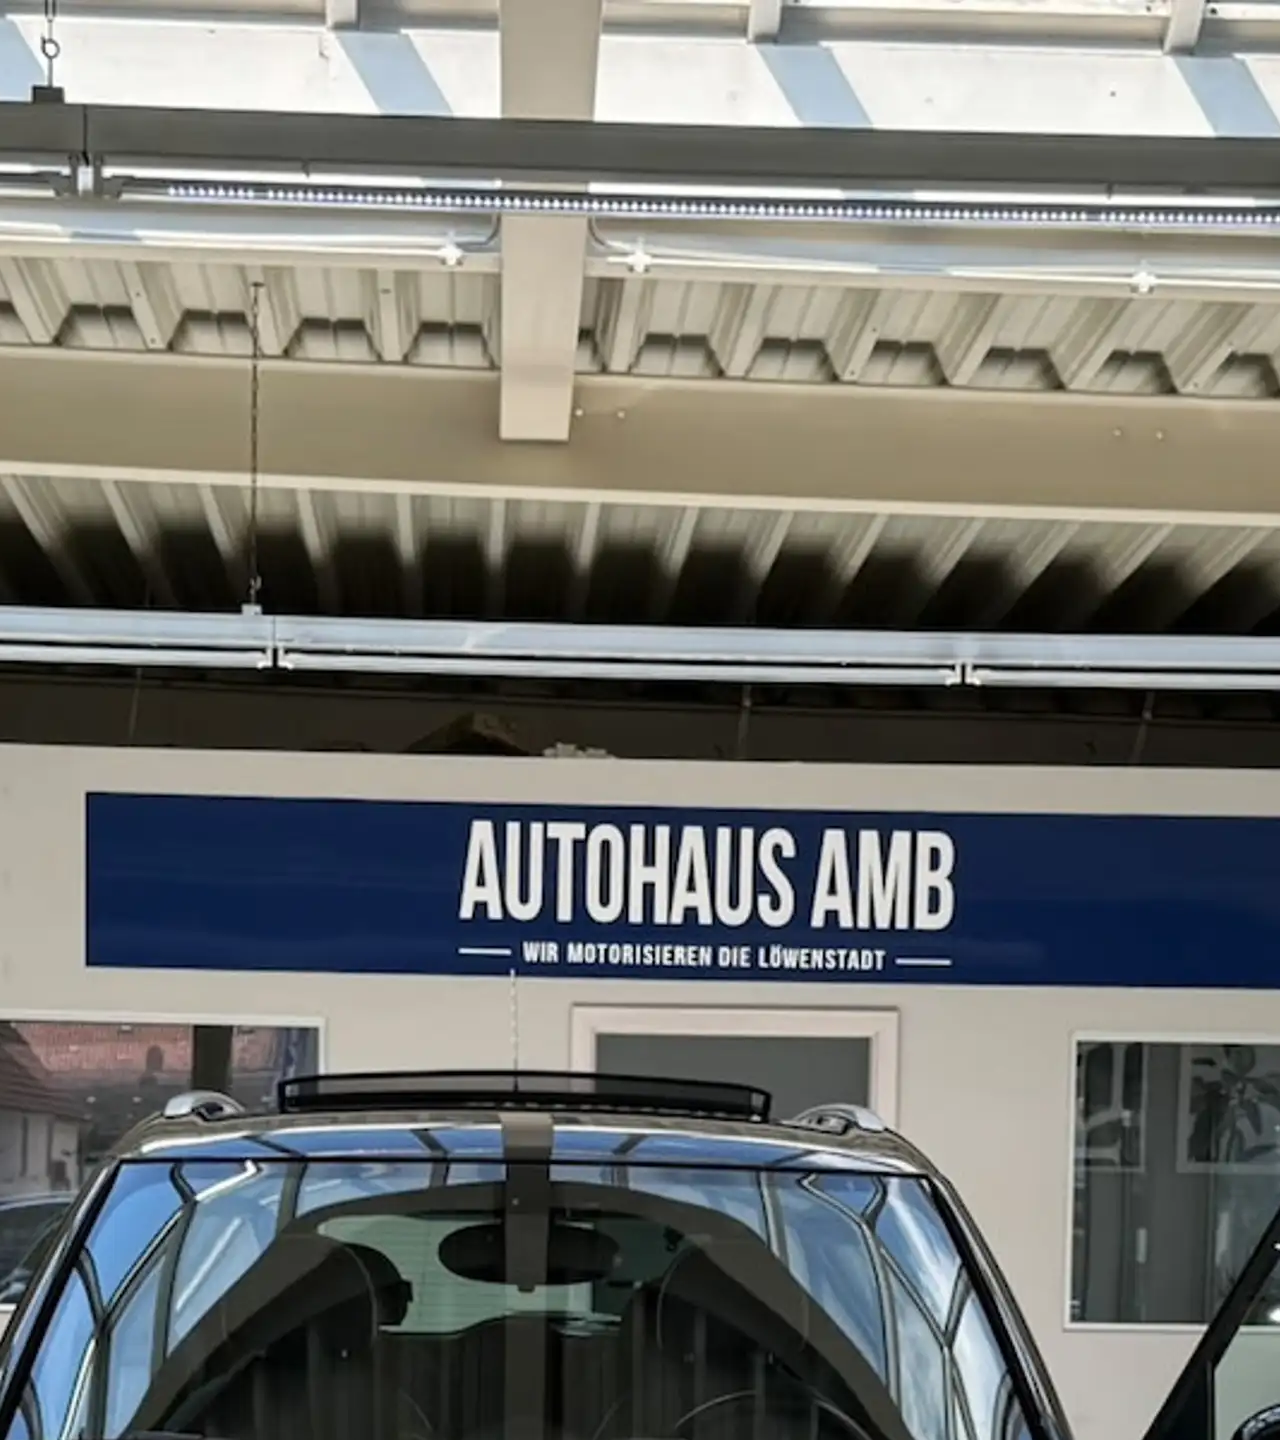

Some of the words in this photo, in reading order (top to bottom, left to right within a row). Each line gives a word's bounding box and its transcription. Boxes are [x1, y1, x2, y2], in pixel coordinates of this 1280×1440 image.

[458, 819, 796, 928] AUTOHAUS
[810, 827, 955, 931] AMB
[522, 940, 559, 964] WIR
[566, 942, 713, 967] MOTORISIEREN
[717, 946, 752, 968] DIE
[757, 944, 887, 971] LÖWENSTADT
